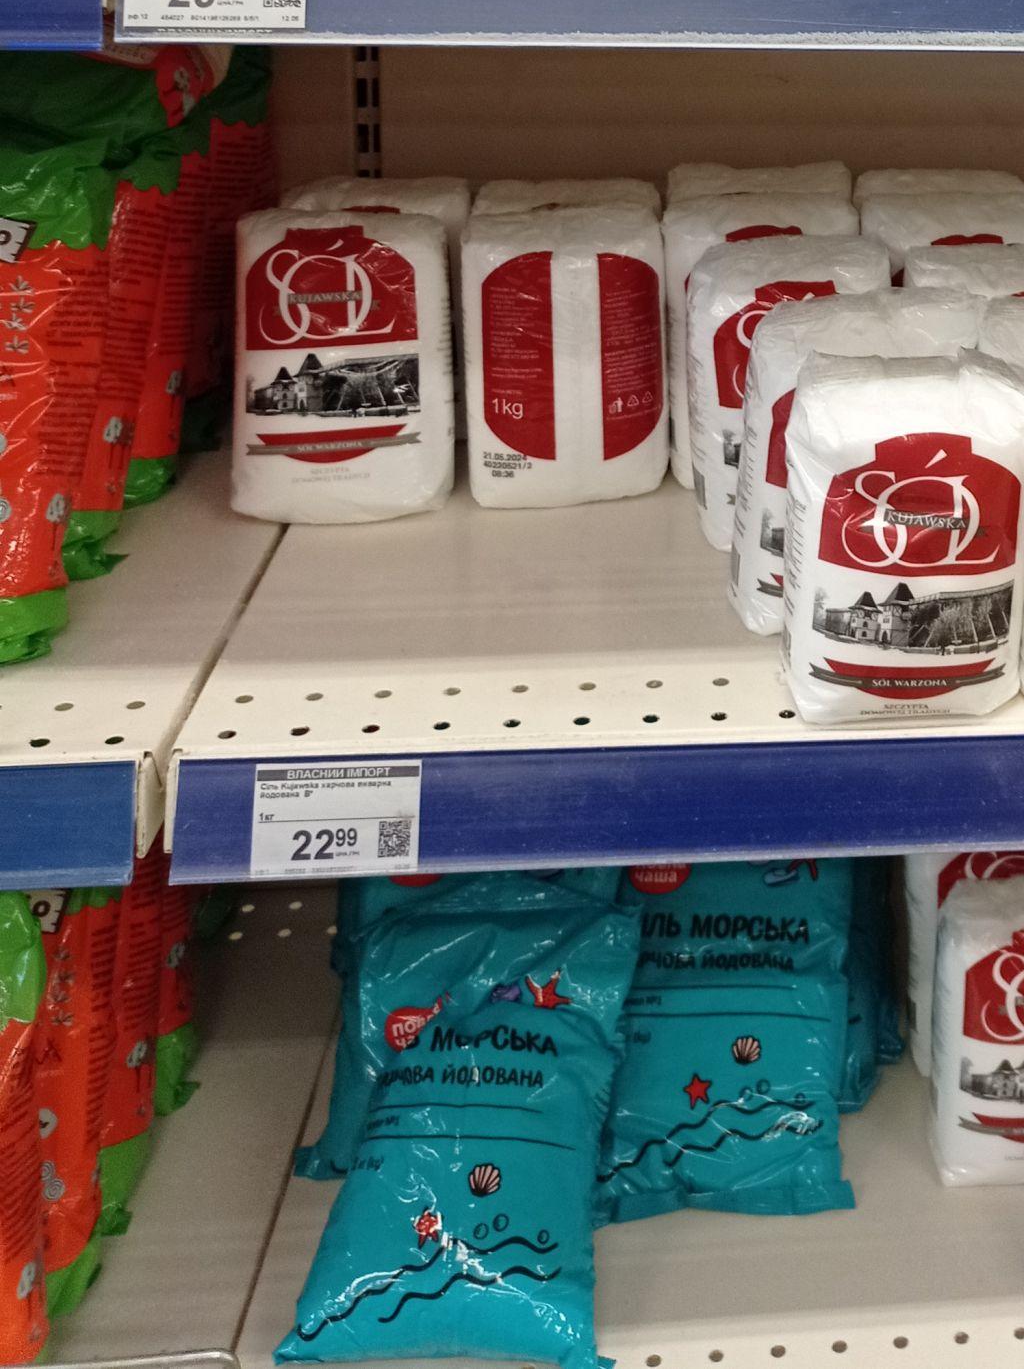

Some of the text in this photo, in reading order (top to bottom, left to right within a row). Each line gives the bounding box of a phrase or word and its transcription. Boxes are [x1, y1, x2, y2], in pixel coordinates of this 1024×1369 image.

[886, 507, 967, 532] KUJAWSKA
[872, 678, 949, 689] SÓL WARZONA
[347, 767, 391, 778] ІМПОРТ
[291, 828, 358, 861] 22 99
[691, 914, 809, 945] МОРСЬКА
[702, 950, 794, 972] ЙОДОВАНА
[441, 1064, 544, 1088] ЙОДОВАНА
